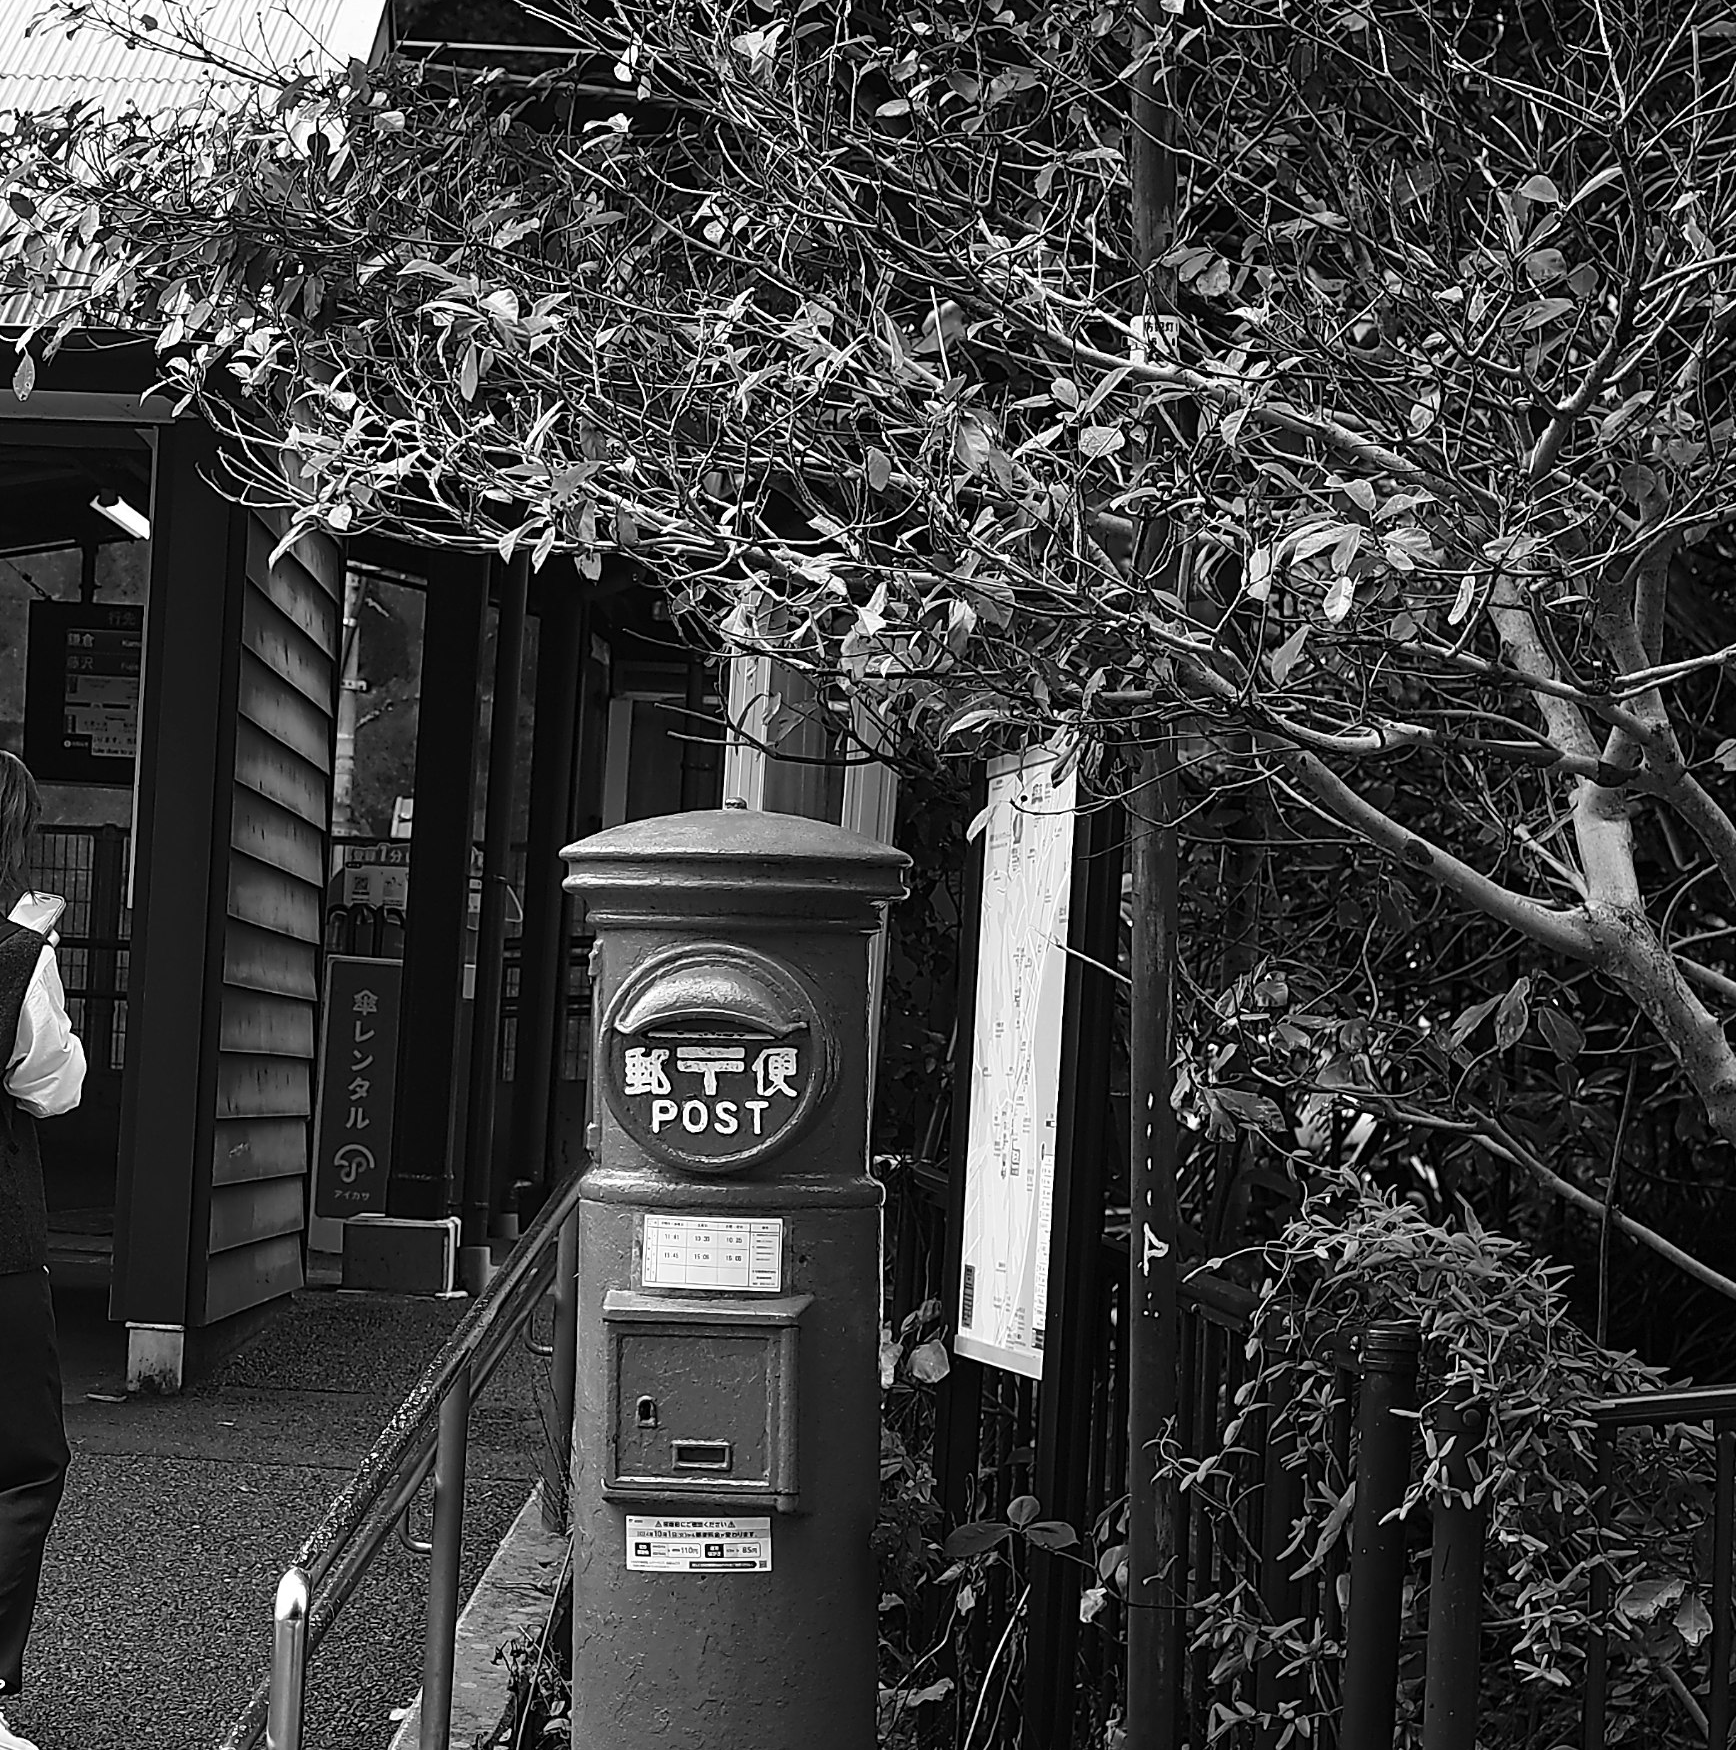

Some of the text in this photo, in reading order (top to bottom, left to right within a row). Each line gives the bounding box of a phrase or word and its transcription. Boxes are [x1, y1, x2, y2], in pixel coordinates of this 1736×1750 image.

[344, 988, 380, 1131] 傘レンタル
[651, 1099, 770, 1136] POST
